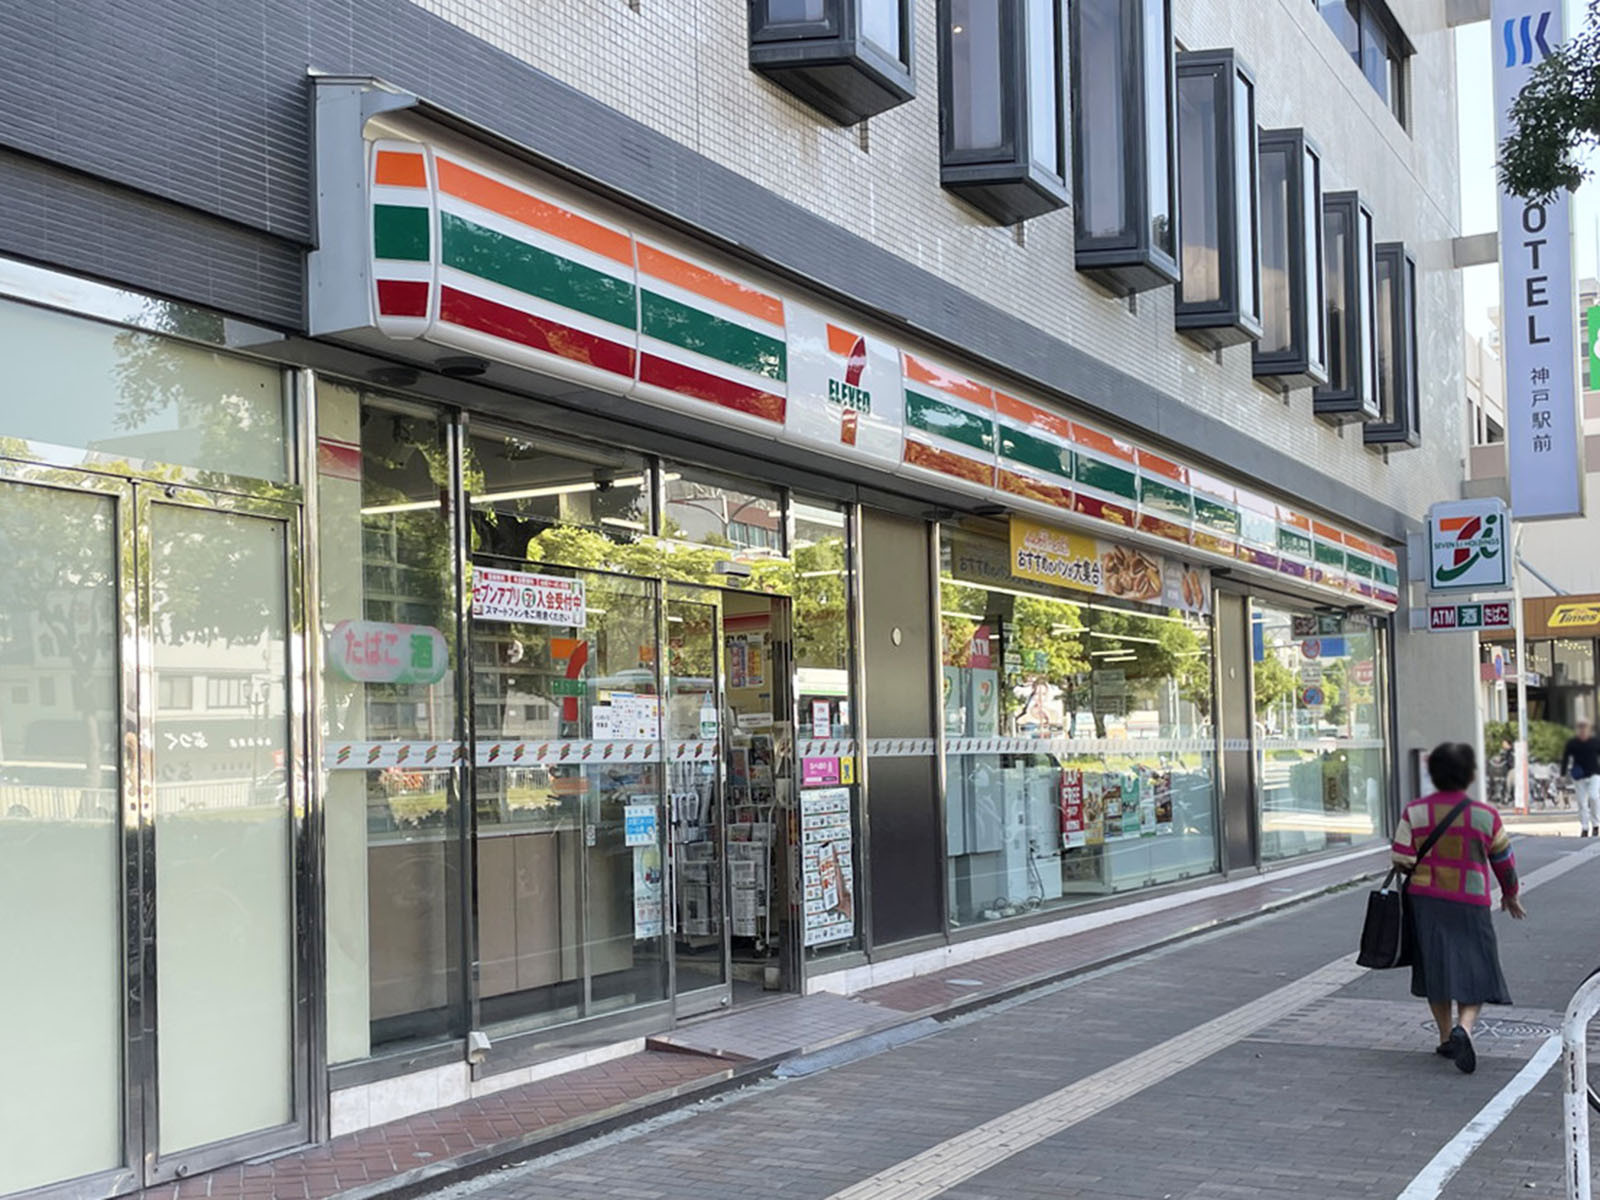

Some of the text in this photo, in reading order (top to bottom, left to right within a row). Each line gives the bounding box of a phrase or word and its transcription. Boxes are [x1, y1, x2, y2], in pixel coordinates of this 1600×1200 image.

[1530, 366, 1551, 452] 神戸駅前
[1431, 609, 1454, 626] ATM
[1461, 607, 1478, 624] 酒
[1485, 605, 1508, 622] たばこ
[1558, 610, 1597, 624] Times
[345, 629, 399, 664] たばこ
